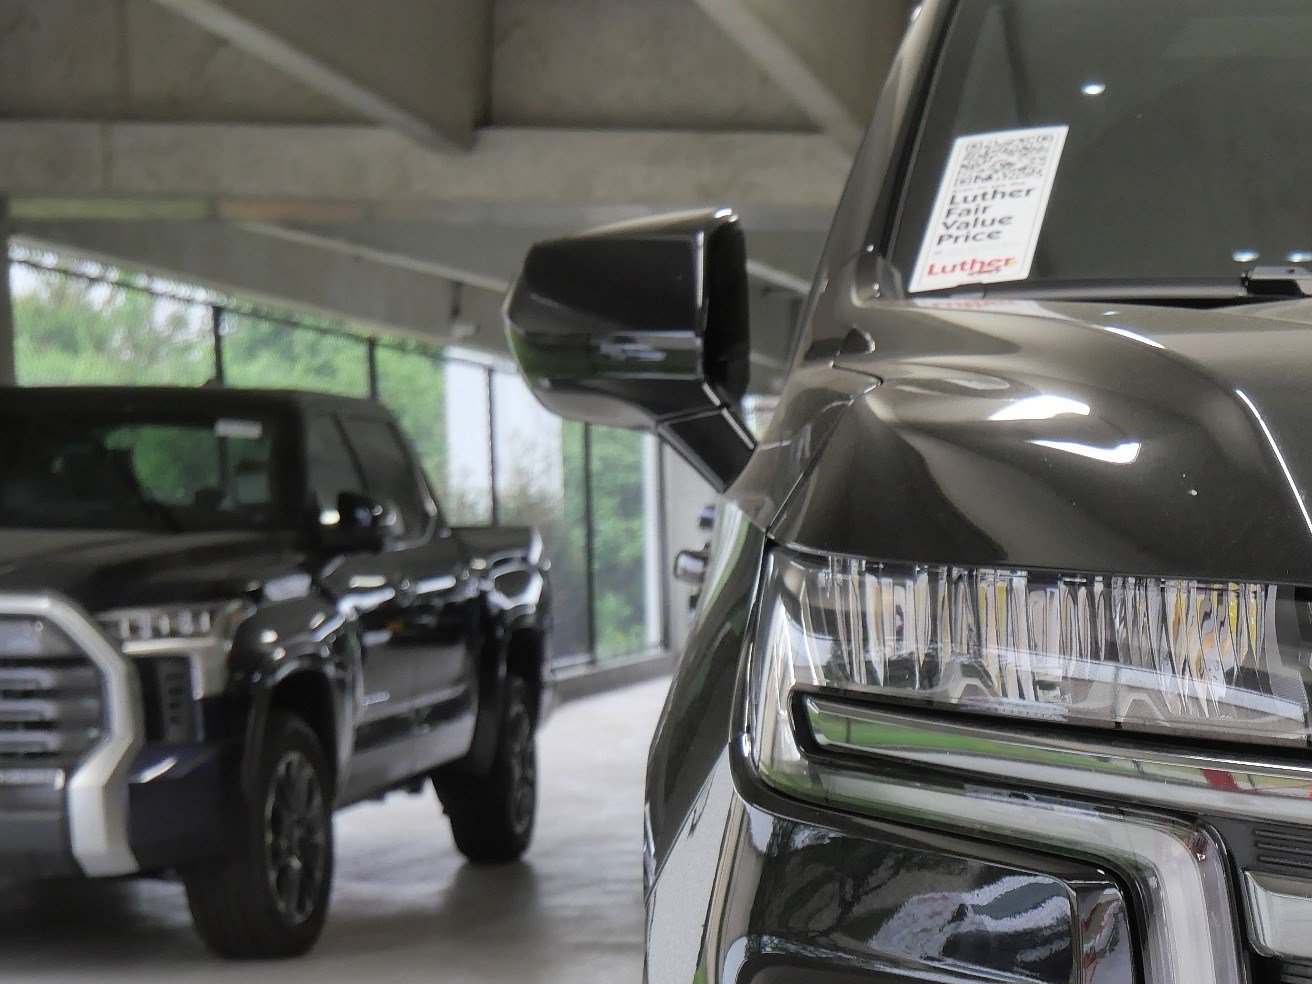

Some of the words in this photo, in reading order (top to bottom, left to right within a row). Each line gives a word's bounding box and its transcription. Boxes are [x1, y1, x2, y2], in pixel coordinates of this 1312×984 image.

[949, 187, 1034, 205] Luther
[945, 203, 991, 219] Fair
[942, 215, 1013, 231] Value
[937, 230, 1001, 245] Price
[928, 257, 1015, 275] Luther
